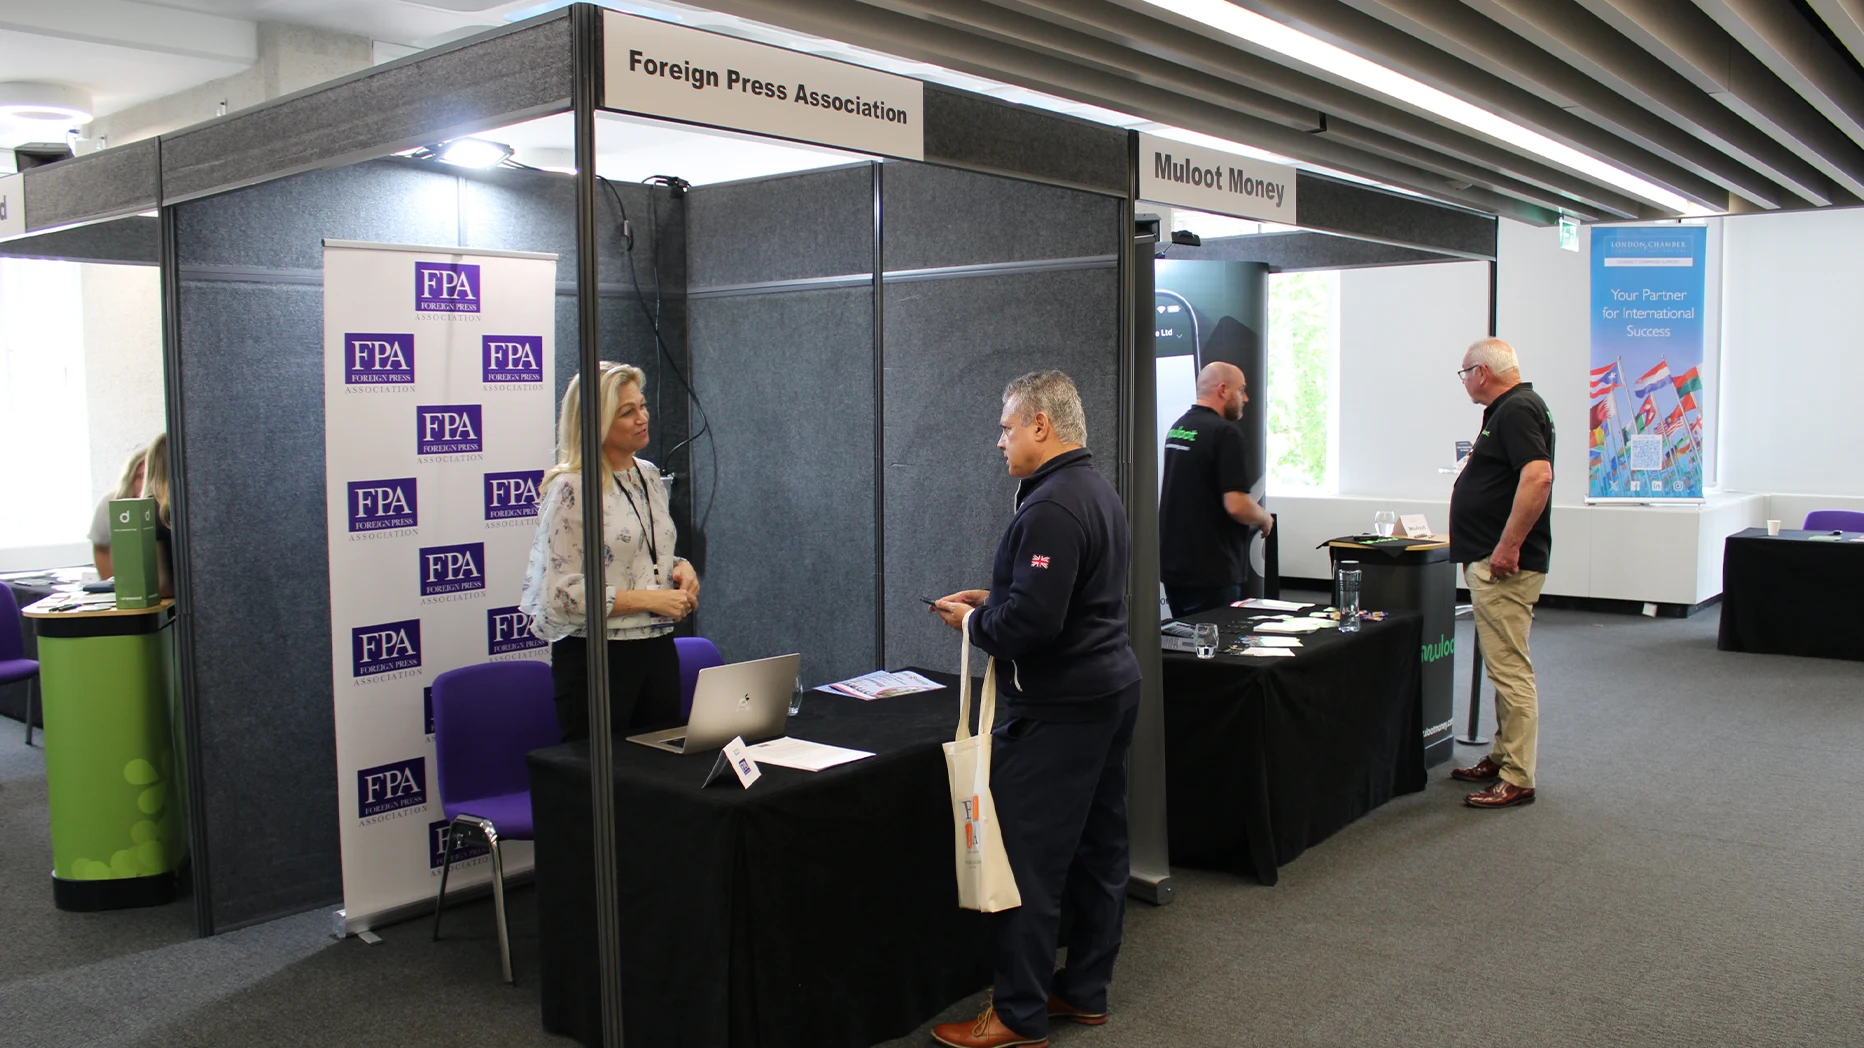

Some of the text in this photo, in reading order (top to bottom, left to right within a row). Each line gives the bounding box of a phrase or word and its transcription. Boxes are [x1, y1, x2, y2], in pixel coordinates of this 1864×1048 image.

[628, 50, 908, 125] Foreign Press Association
[1154, 152, 1285, 208] Muloot Money
[421, 269, 476, 300] FPA
[1611, 288, 1687, 301] Your Partner
[421, 302, 477, 311] FOREIGN PRESS
[1602, 307, 1695, 319] for International
[415, 313, 481, 322] ASSOCIATION
[1626, 325, 1671, 337] Success
[351, 340, 410, 370] FPA
[487, 342, 539, 370] FPA
[388, 374, 410, 382] PRESS
[344, 386, 416, 394] ASSOCIATION
[483, 384, 544, 392] ASSOCIATION
[423, 411, 477, 441] FPA
[423, 443, 479, 452] FOREIGN PRESS
[417, 454, 483, 464] ASSOCIATION
[490, 478, 540, 506] FPA
[354, 485, 412, 518] FPA
[490, 509, 521, 518] FOREIGN
[356, 518, 413, 530] FOREIGN PRESS
[348, 528, 419, 542] ASSOCIATION
[425, 551, 480, 582] FPA
[426, 581, 482, 594] FOREIGN PRESS
[420, 590, 486, 606] ASSOCIATION
[359, 628, 416, 663] FPA
[494, 642, 524, 652] FOREIGN
[360, 659, 417, 674] FOREIGN PRESS
[353, 669, 422, 686] ASSOCIATION
[365, 767, 421, 804] FPA
[365, 796, 423, 814] FOREIGN PRESS
[359, 805, 428, 827] ASSOCIATION
